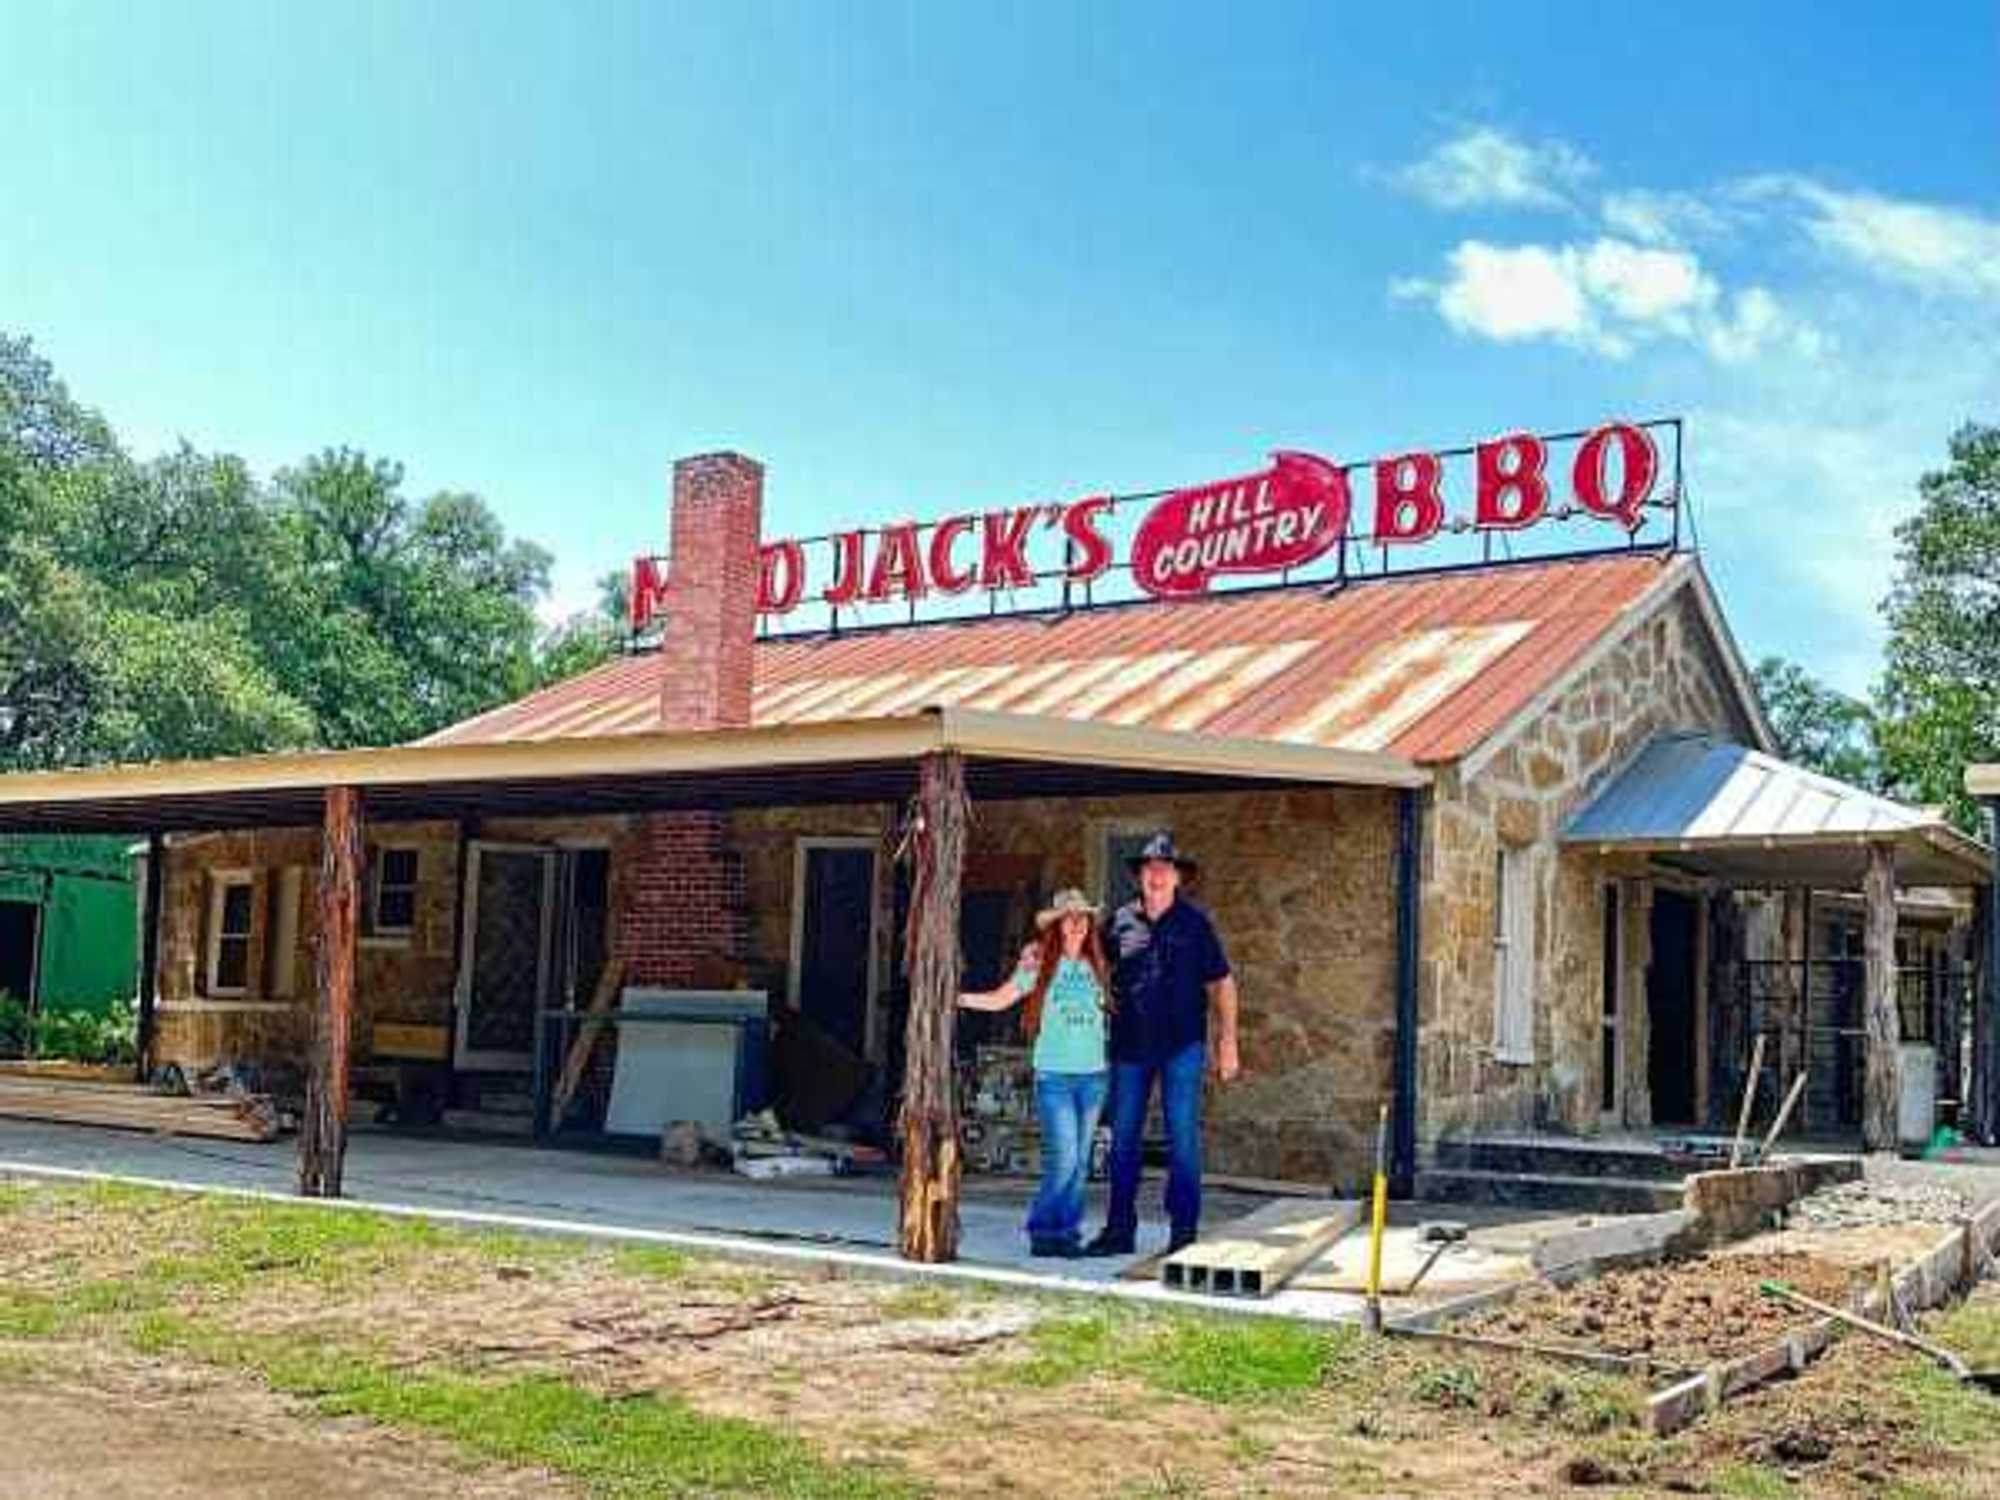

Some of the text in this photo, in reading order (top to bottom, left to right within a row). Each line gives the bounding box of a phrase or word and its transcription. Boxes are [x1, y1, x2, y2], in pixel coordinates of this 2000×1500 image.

[1152, 502, 1324, 582] COUNTRY
[1187, 478, 1275, 534] HILL
[631, 496, 1116, 628] MD JACK'S
